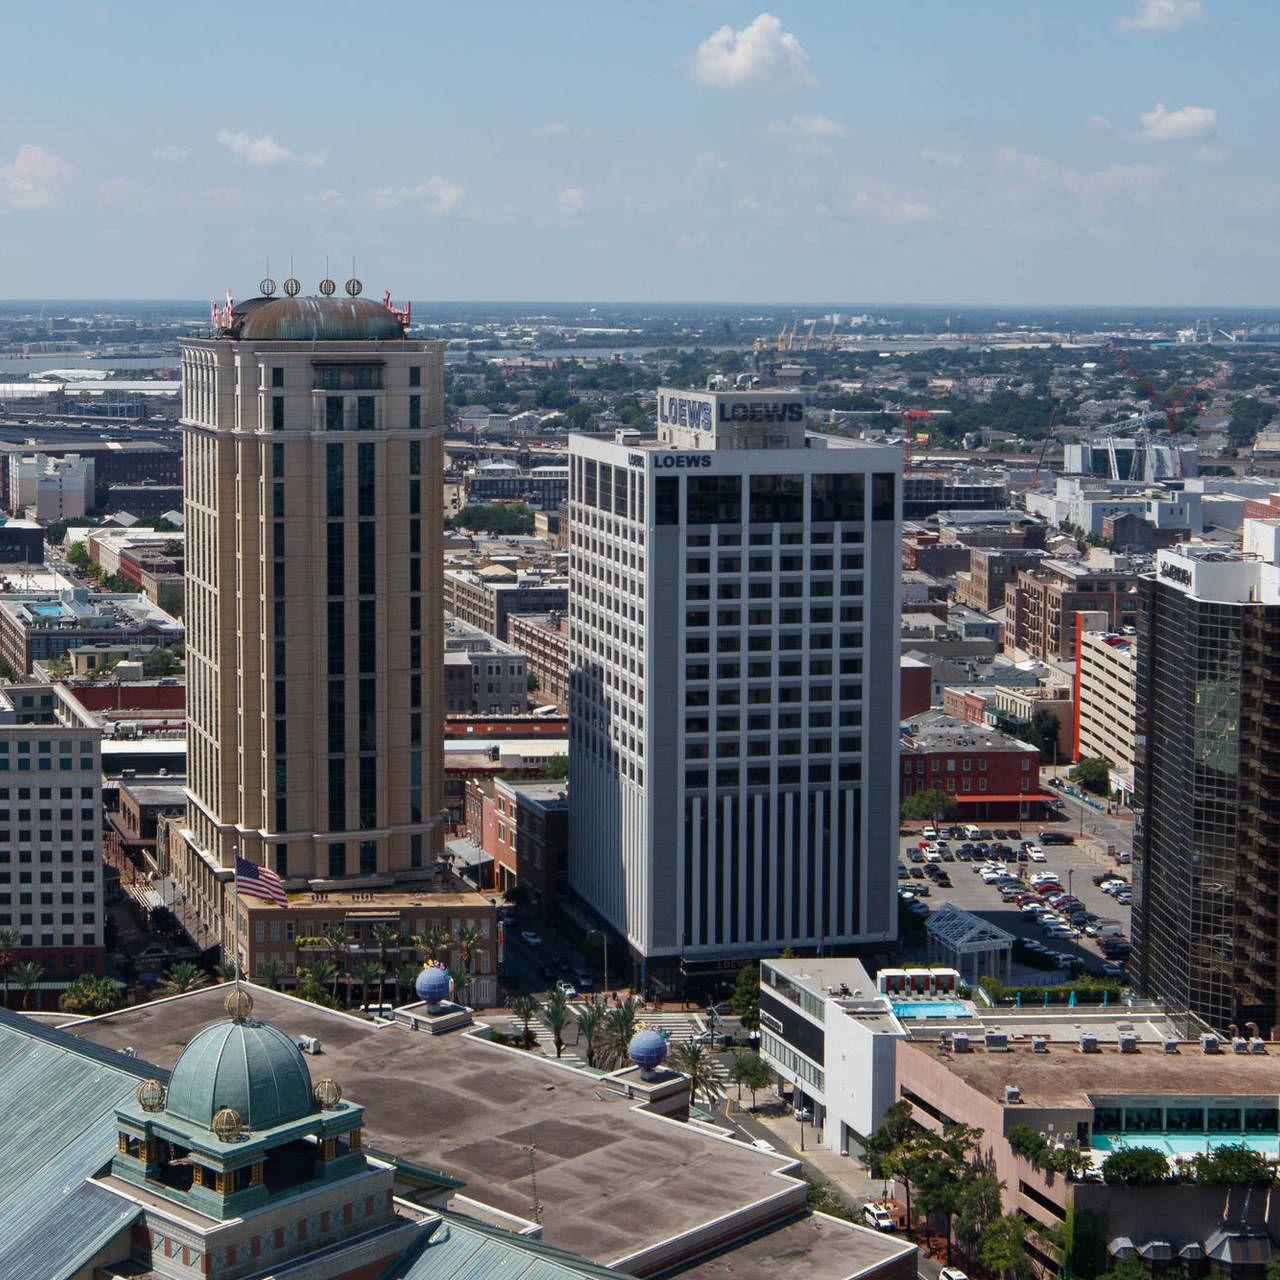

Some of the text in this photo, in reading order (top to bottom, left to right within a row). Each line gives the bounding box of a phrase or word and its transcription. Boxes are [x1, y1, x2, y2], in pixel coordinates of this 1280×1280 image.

[659, 395, 713, 431] LOEWS
[720, 403, 804, 422] LOEWS
[654, 454, 712, 468] LOEWS
